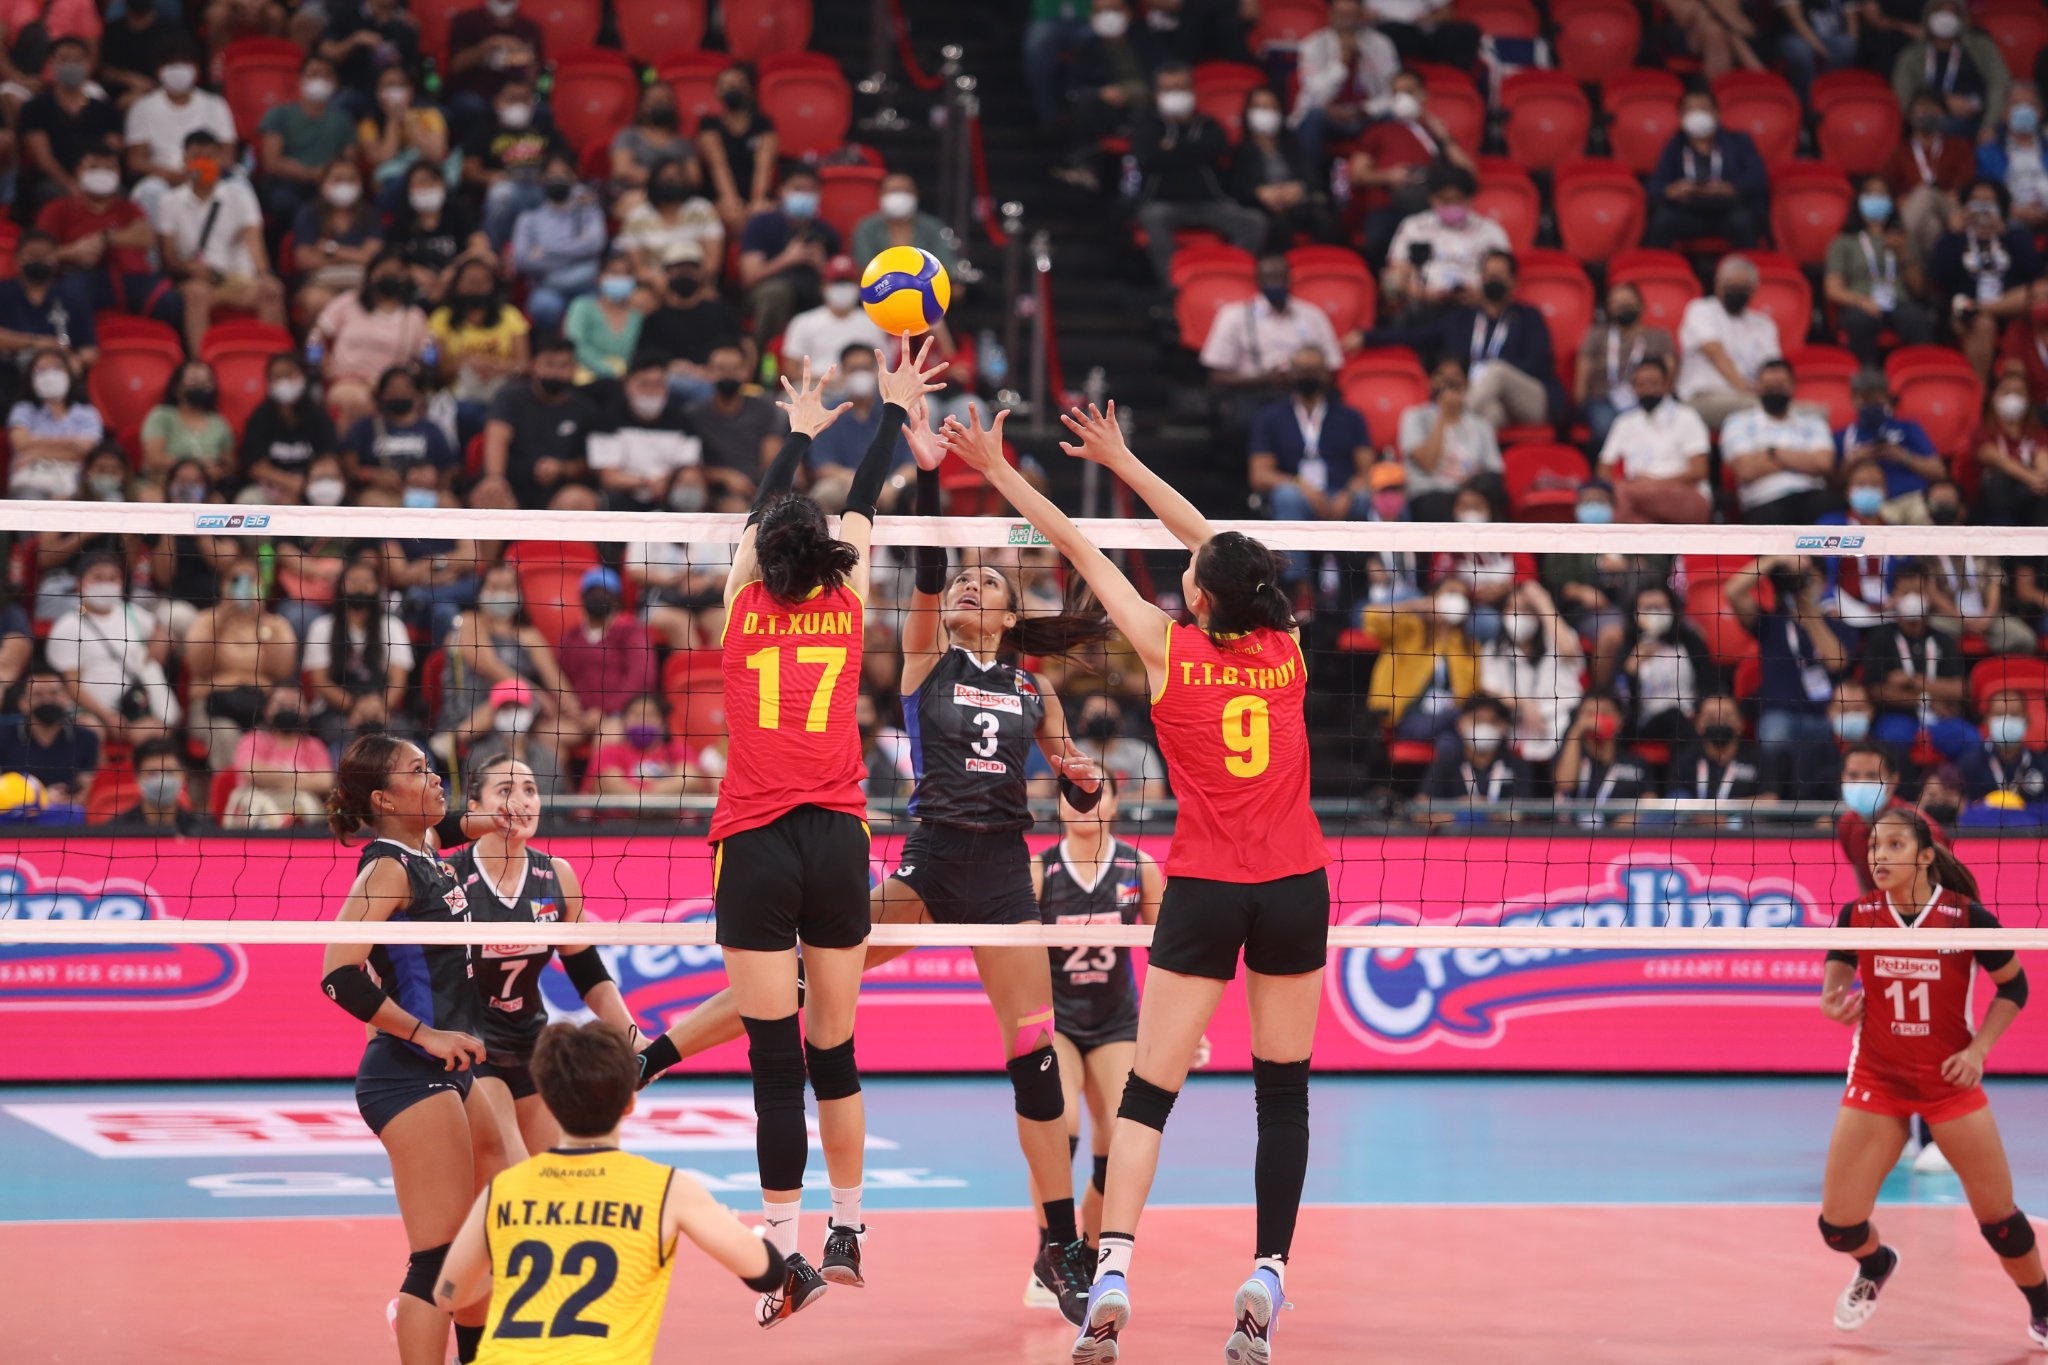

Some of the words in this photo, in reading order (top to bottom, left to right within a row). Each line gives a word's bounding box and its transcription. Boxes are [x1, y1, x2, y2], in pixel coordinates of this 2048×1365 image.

[197, 517, 228, 526] PPTV
[248, 516, 266, 526] 36
[1010, 529, 1030, 537] EURO
[1844, 538, 1861, 546] 36
[742, 611, 853, 635] D.T.XUAN
[1180, 656, 1297, 690] T.T.B.THUY
[745, 645, 848, 733] 17
[956, 685, 1020, 708] Rebisco
[970, 711, 1000, 758] 3
[1221, 694, 1270, 778] 9
[1061, 946, 1117, 972] 23
[1877, 959, 1938, 974] Rebisco
[500, 958, 529, 999] 7
[1884, 980, 1931, 1022] 11
[496, 1200, 644, 1231] N.T.K.LIEN
[492, 1239, 619, 1339] 22
